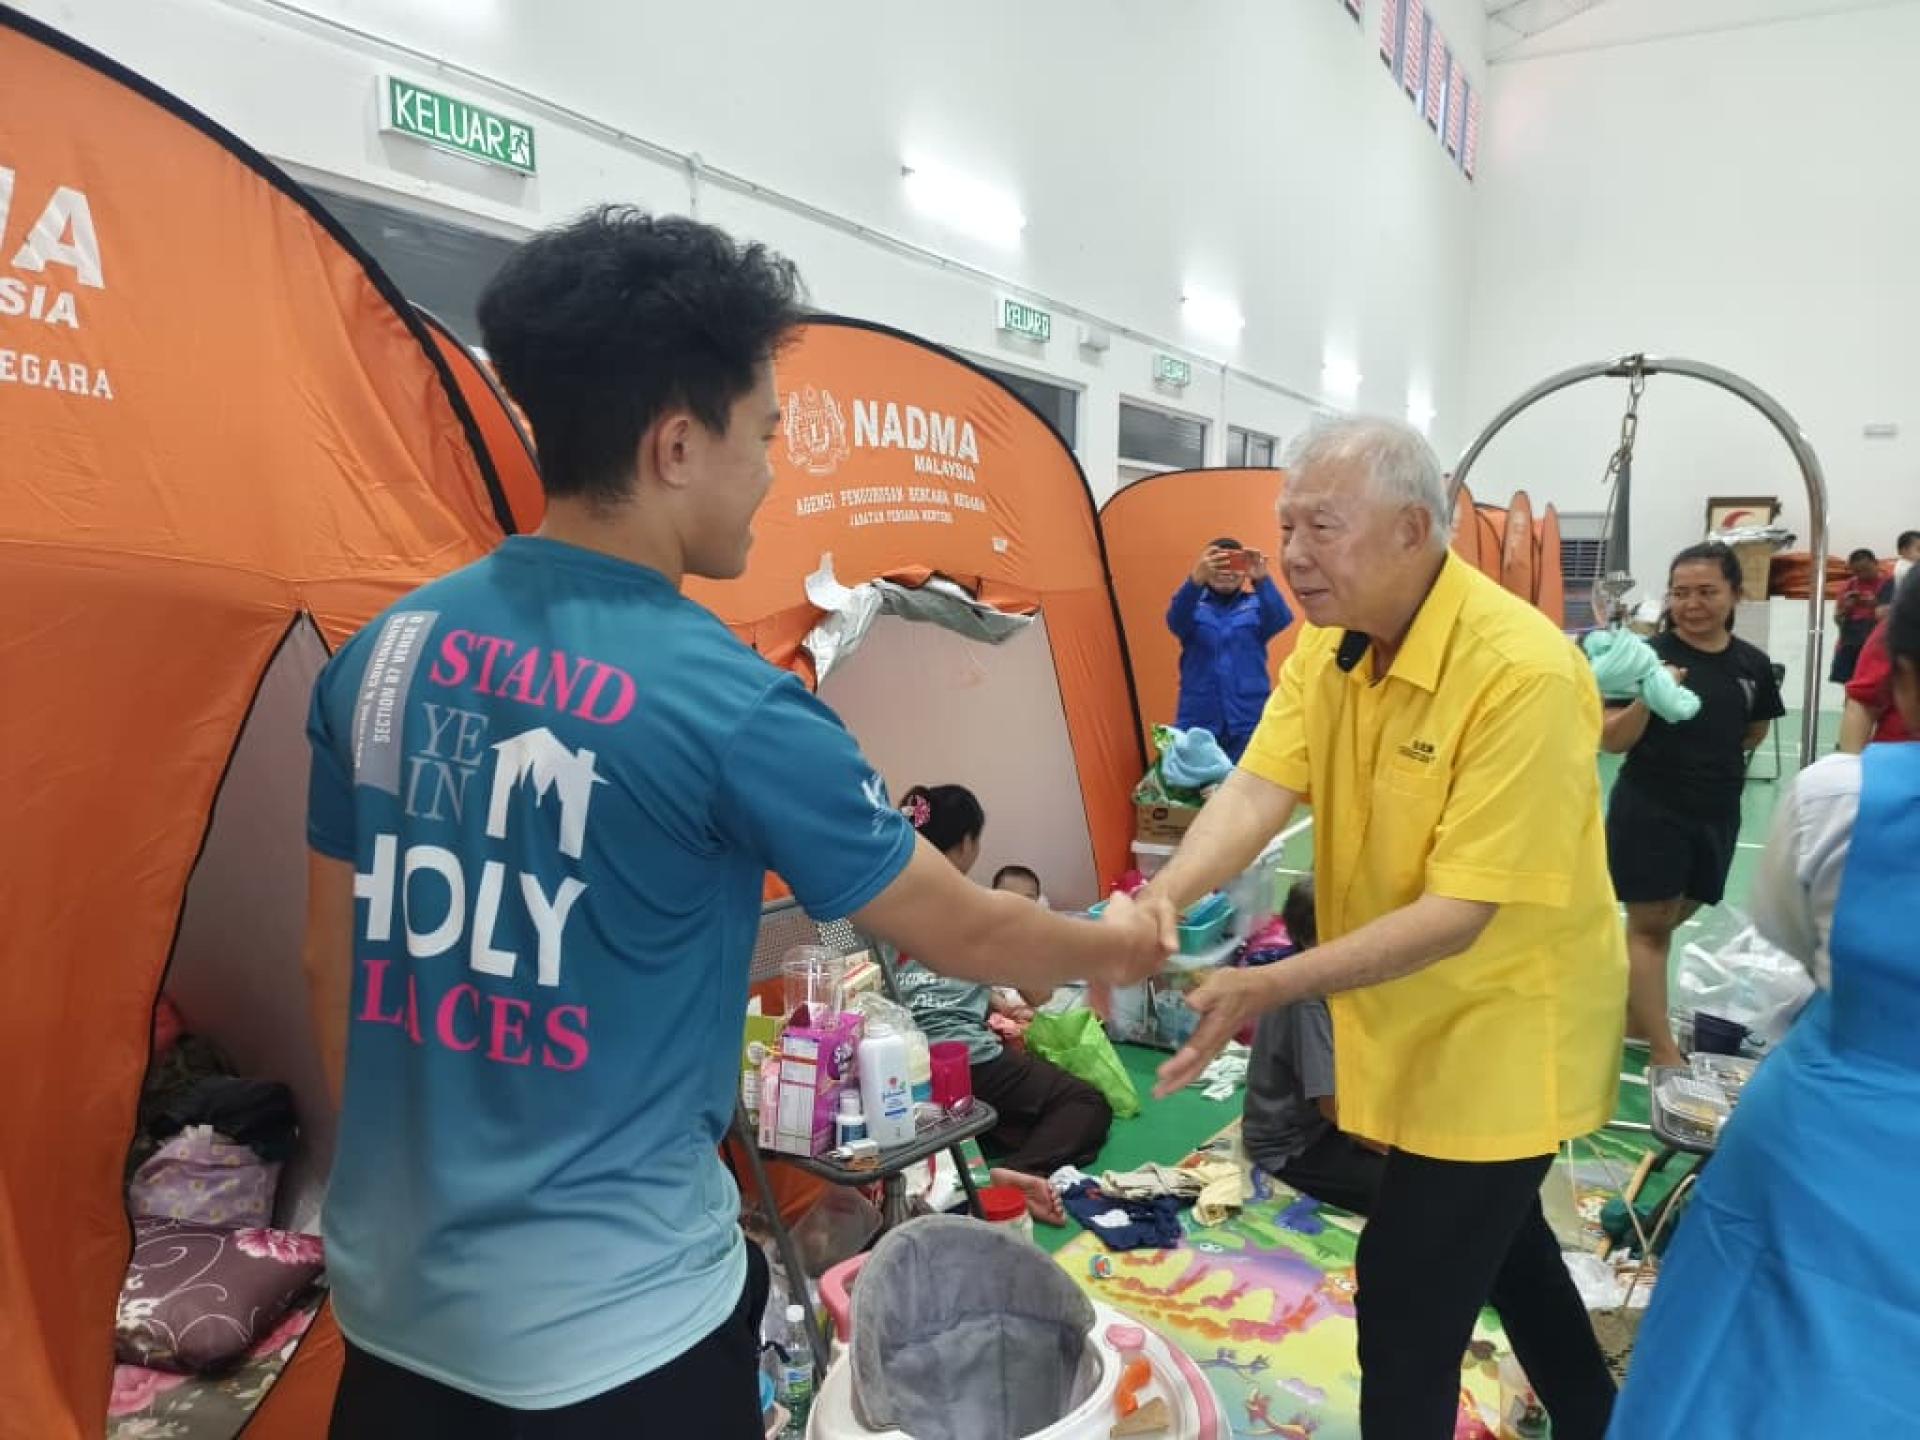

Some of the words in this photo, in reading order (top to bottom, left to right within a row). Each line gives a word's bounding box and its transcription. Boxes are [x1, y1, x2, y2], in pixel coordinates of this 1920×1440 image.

[395, 84, 506, 158] KELUAR
[0, 347, 113, 400] EGARA
[853, 399, 980, 464] NADMA
[914, 455, 976, 484] MALAYSIA
[429, 629, 637, 725] STAND
[373, 687, 398, 744] SECTION
[419, 702, 489, 766] YE
[404, 756, 477, 825] IN
[354, 834, 588, 987] HOLY
